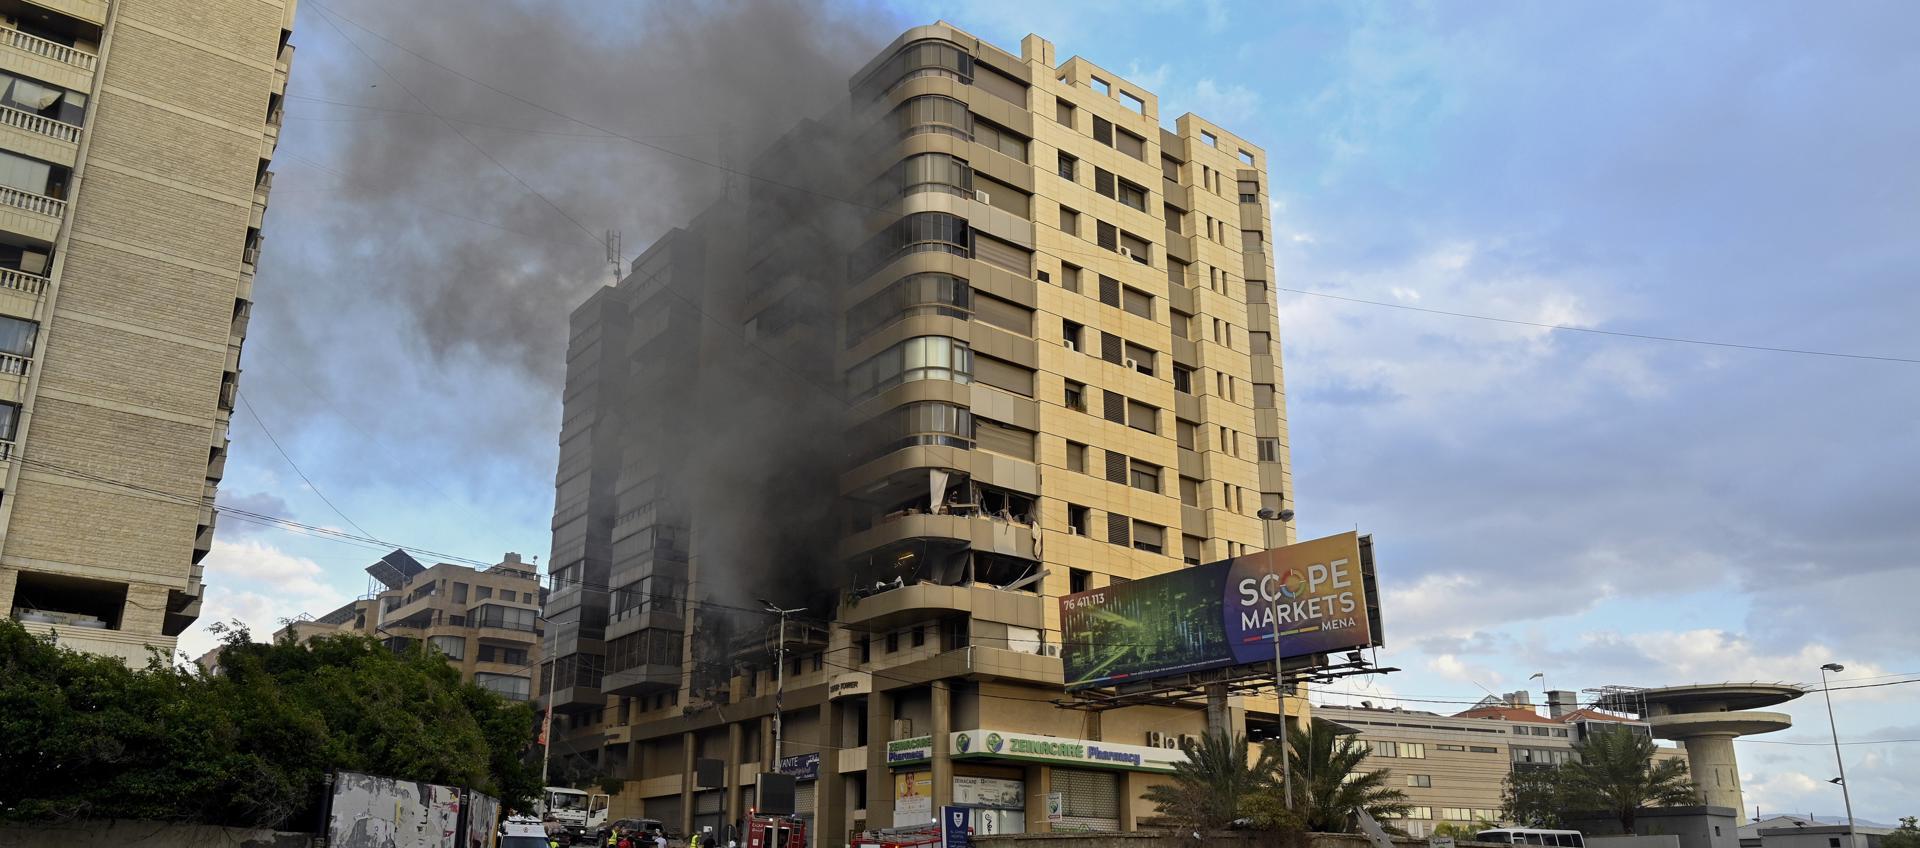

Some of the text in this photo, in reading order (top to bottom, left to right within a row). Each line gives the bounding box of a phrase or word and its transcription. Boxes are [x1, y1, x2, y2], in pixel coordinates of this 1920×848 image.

[1239, 559, 1351, 606] SCOPE
[1064, 593, 1105, 610] 76 411 113
[1241, 592, 1355, 631] MARKETS
[1322, 617, 1356, 632] MENA
[1010, 738, 1140, 766] ZEINACARE Pharmacy
[772, 757, 799, 770] LVANTE
